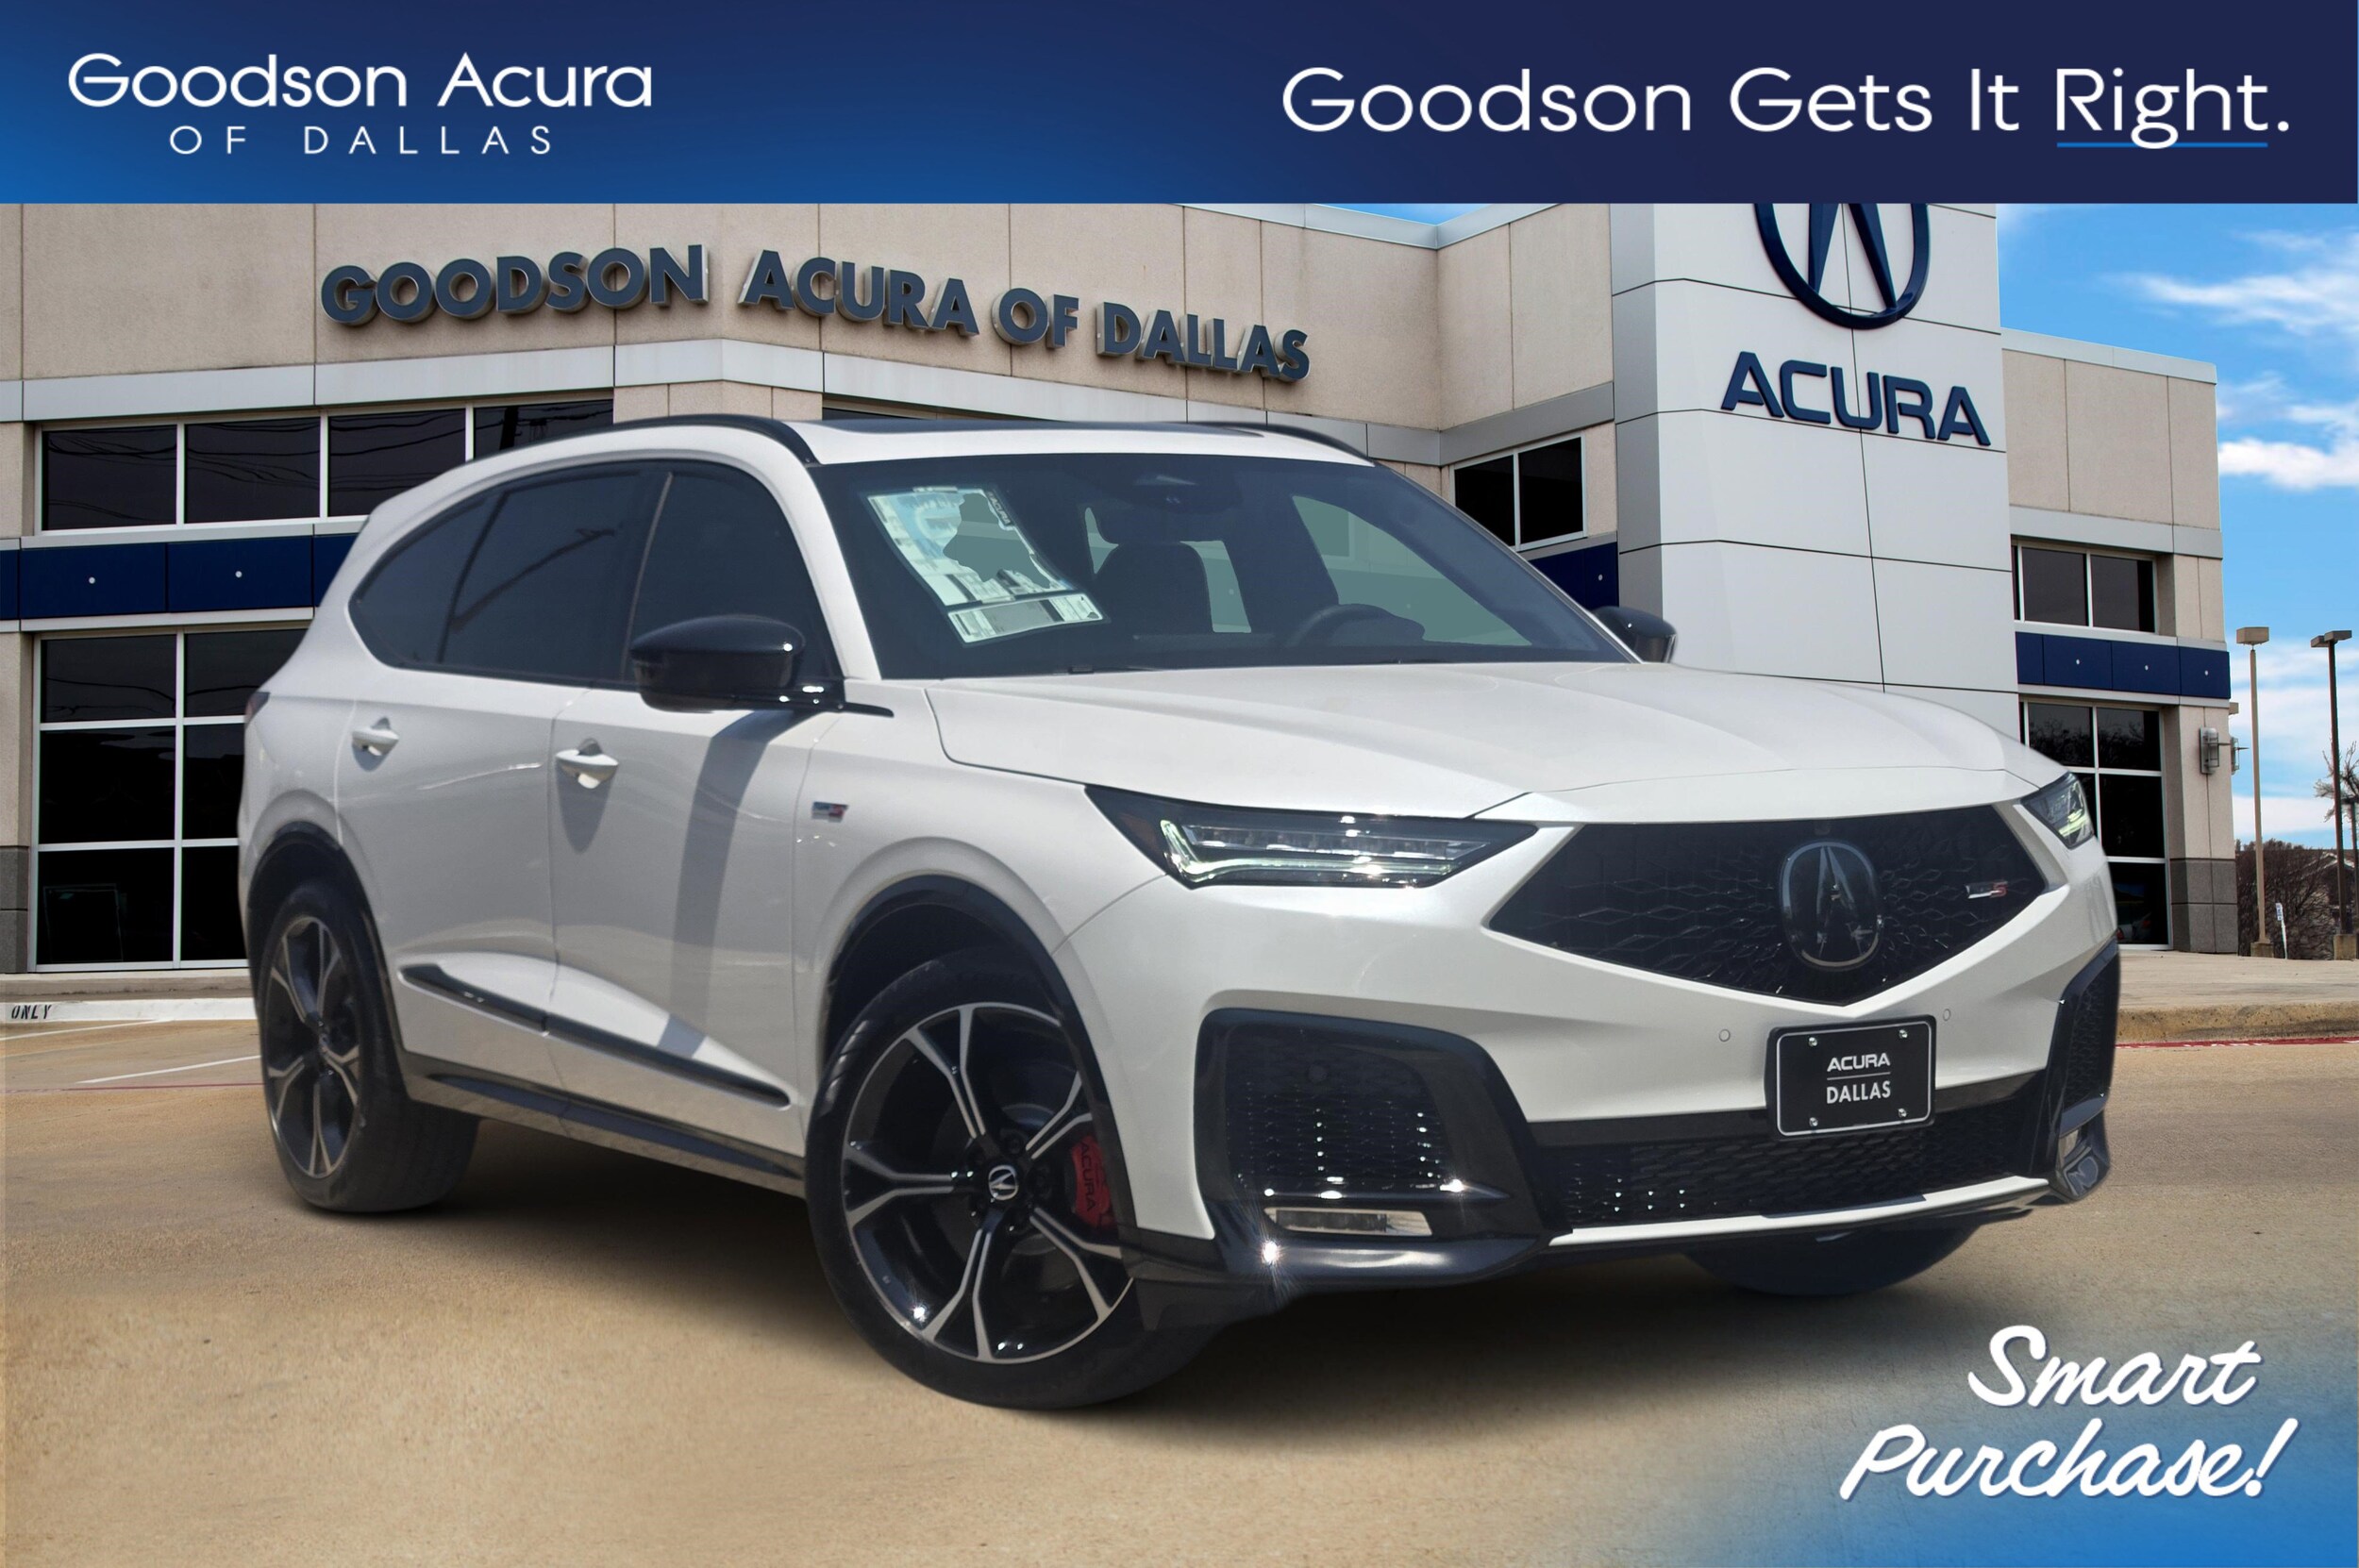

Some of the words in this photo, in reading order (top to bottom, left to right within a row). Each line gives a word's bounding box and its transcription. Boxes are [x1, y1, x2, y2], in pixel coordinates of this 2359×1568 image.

[321, 244, 709, 325] GOODSON
[738, 249, 979, 336] ACURA
[992, 287, 1079, 349] OF
[1096, 301, 1311, 382] DALLAS
[1721, 351, 1992, 446] ACURA
[11, 1005, 52, 1020] ONLY
[1827, 1053, 1891, 1072] ACURA
[1826, 1080, 1891, 1104] DALLAS
[1081, 1143, 1096, 1212] ACURA
